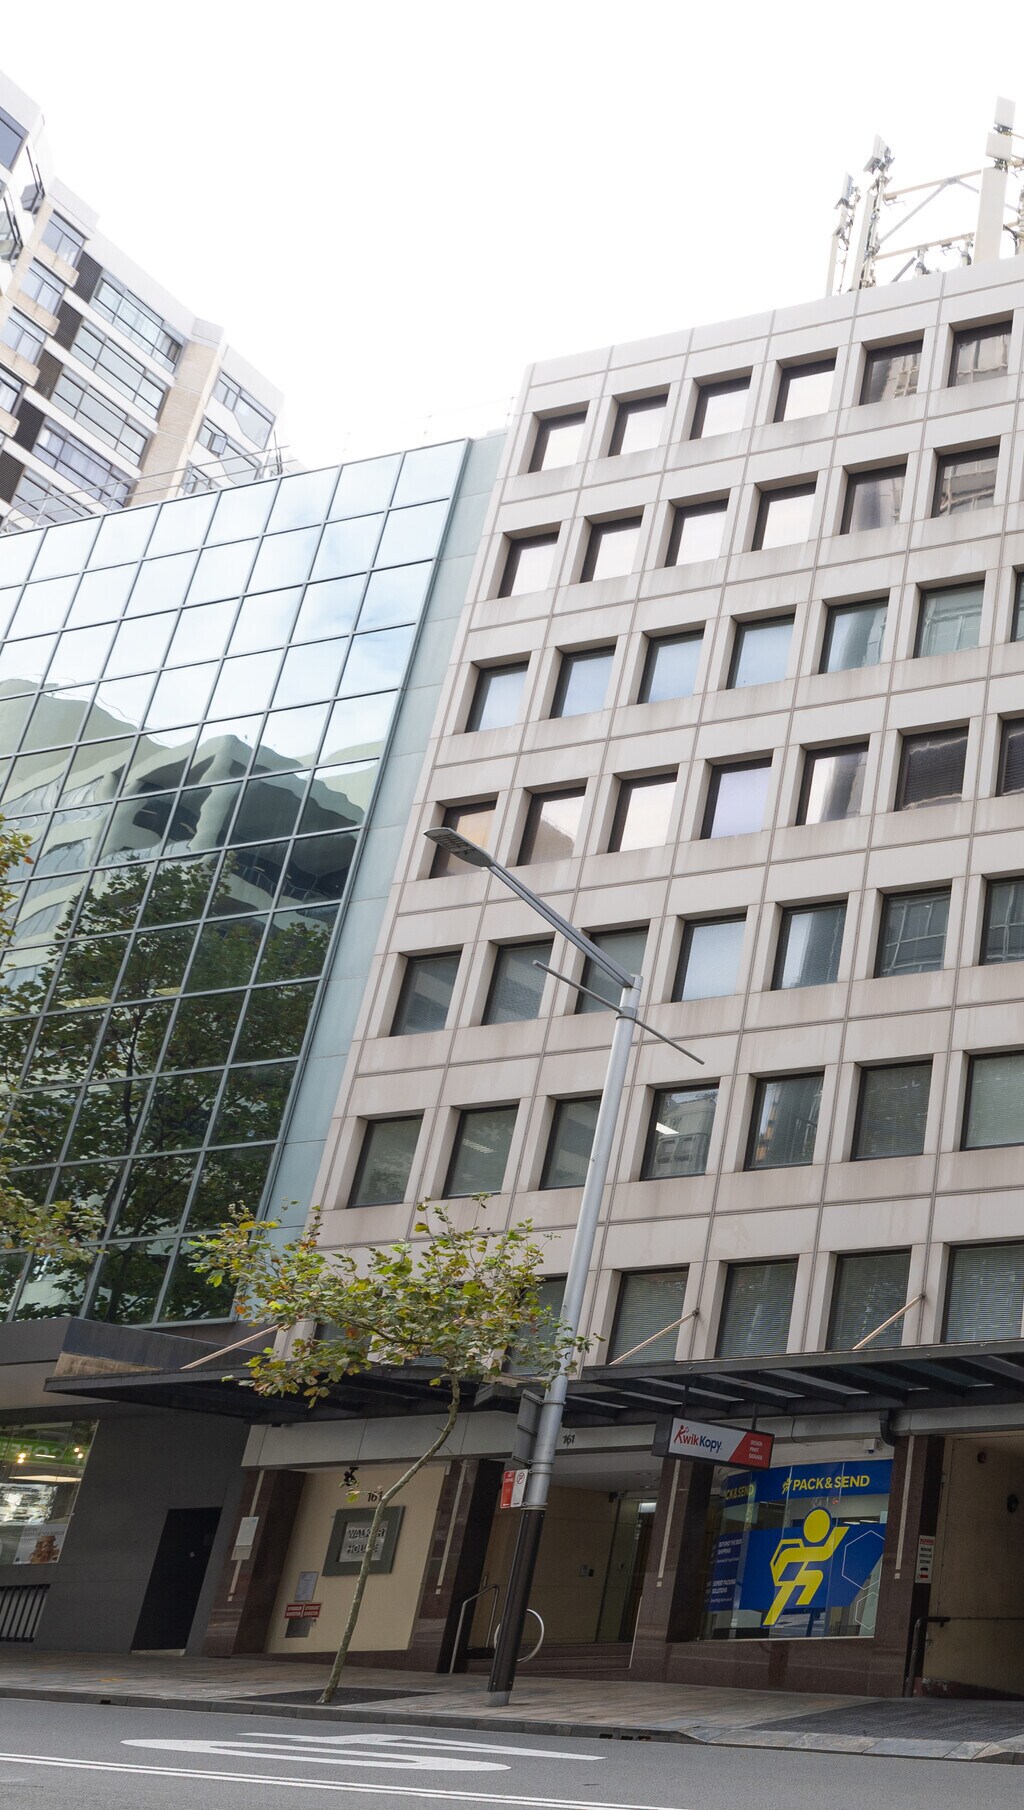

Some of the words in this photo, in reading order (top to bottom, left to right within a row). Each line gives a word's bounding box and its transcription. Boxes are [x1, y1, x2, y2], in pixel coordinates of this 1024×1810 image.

[562, 1434, 576, 1446] 161
[348, 1528, 385, 1539] WALKR
[347, 1544, 379, 1554] HOUE
